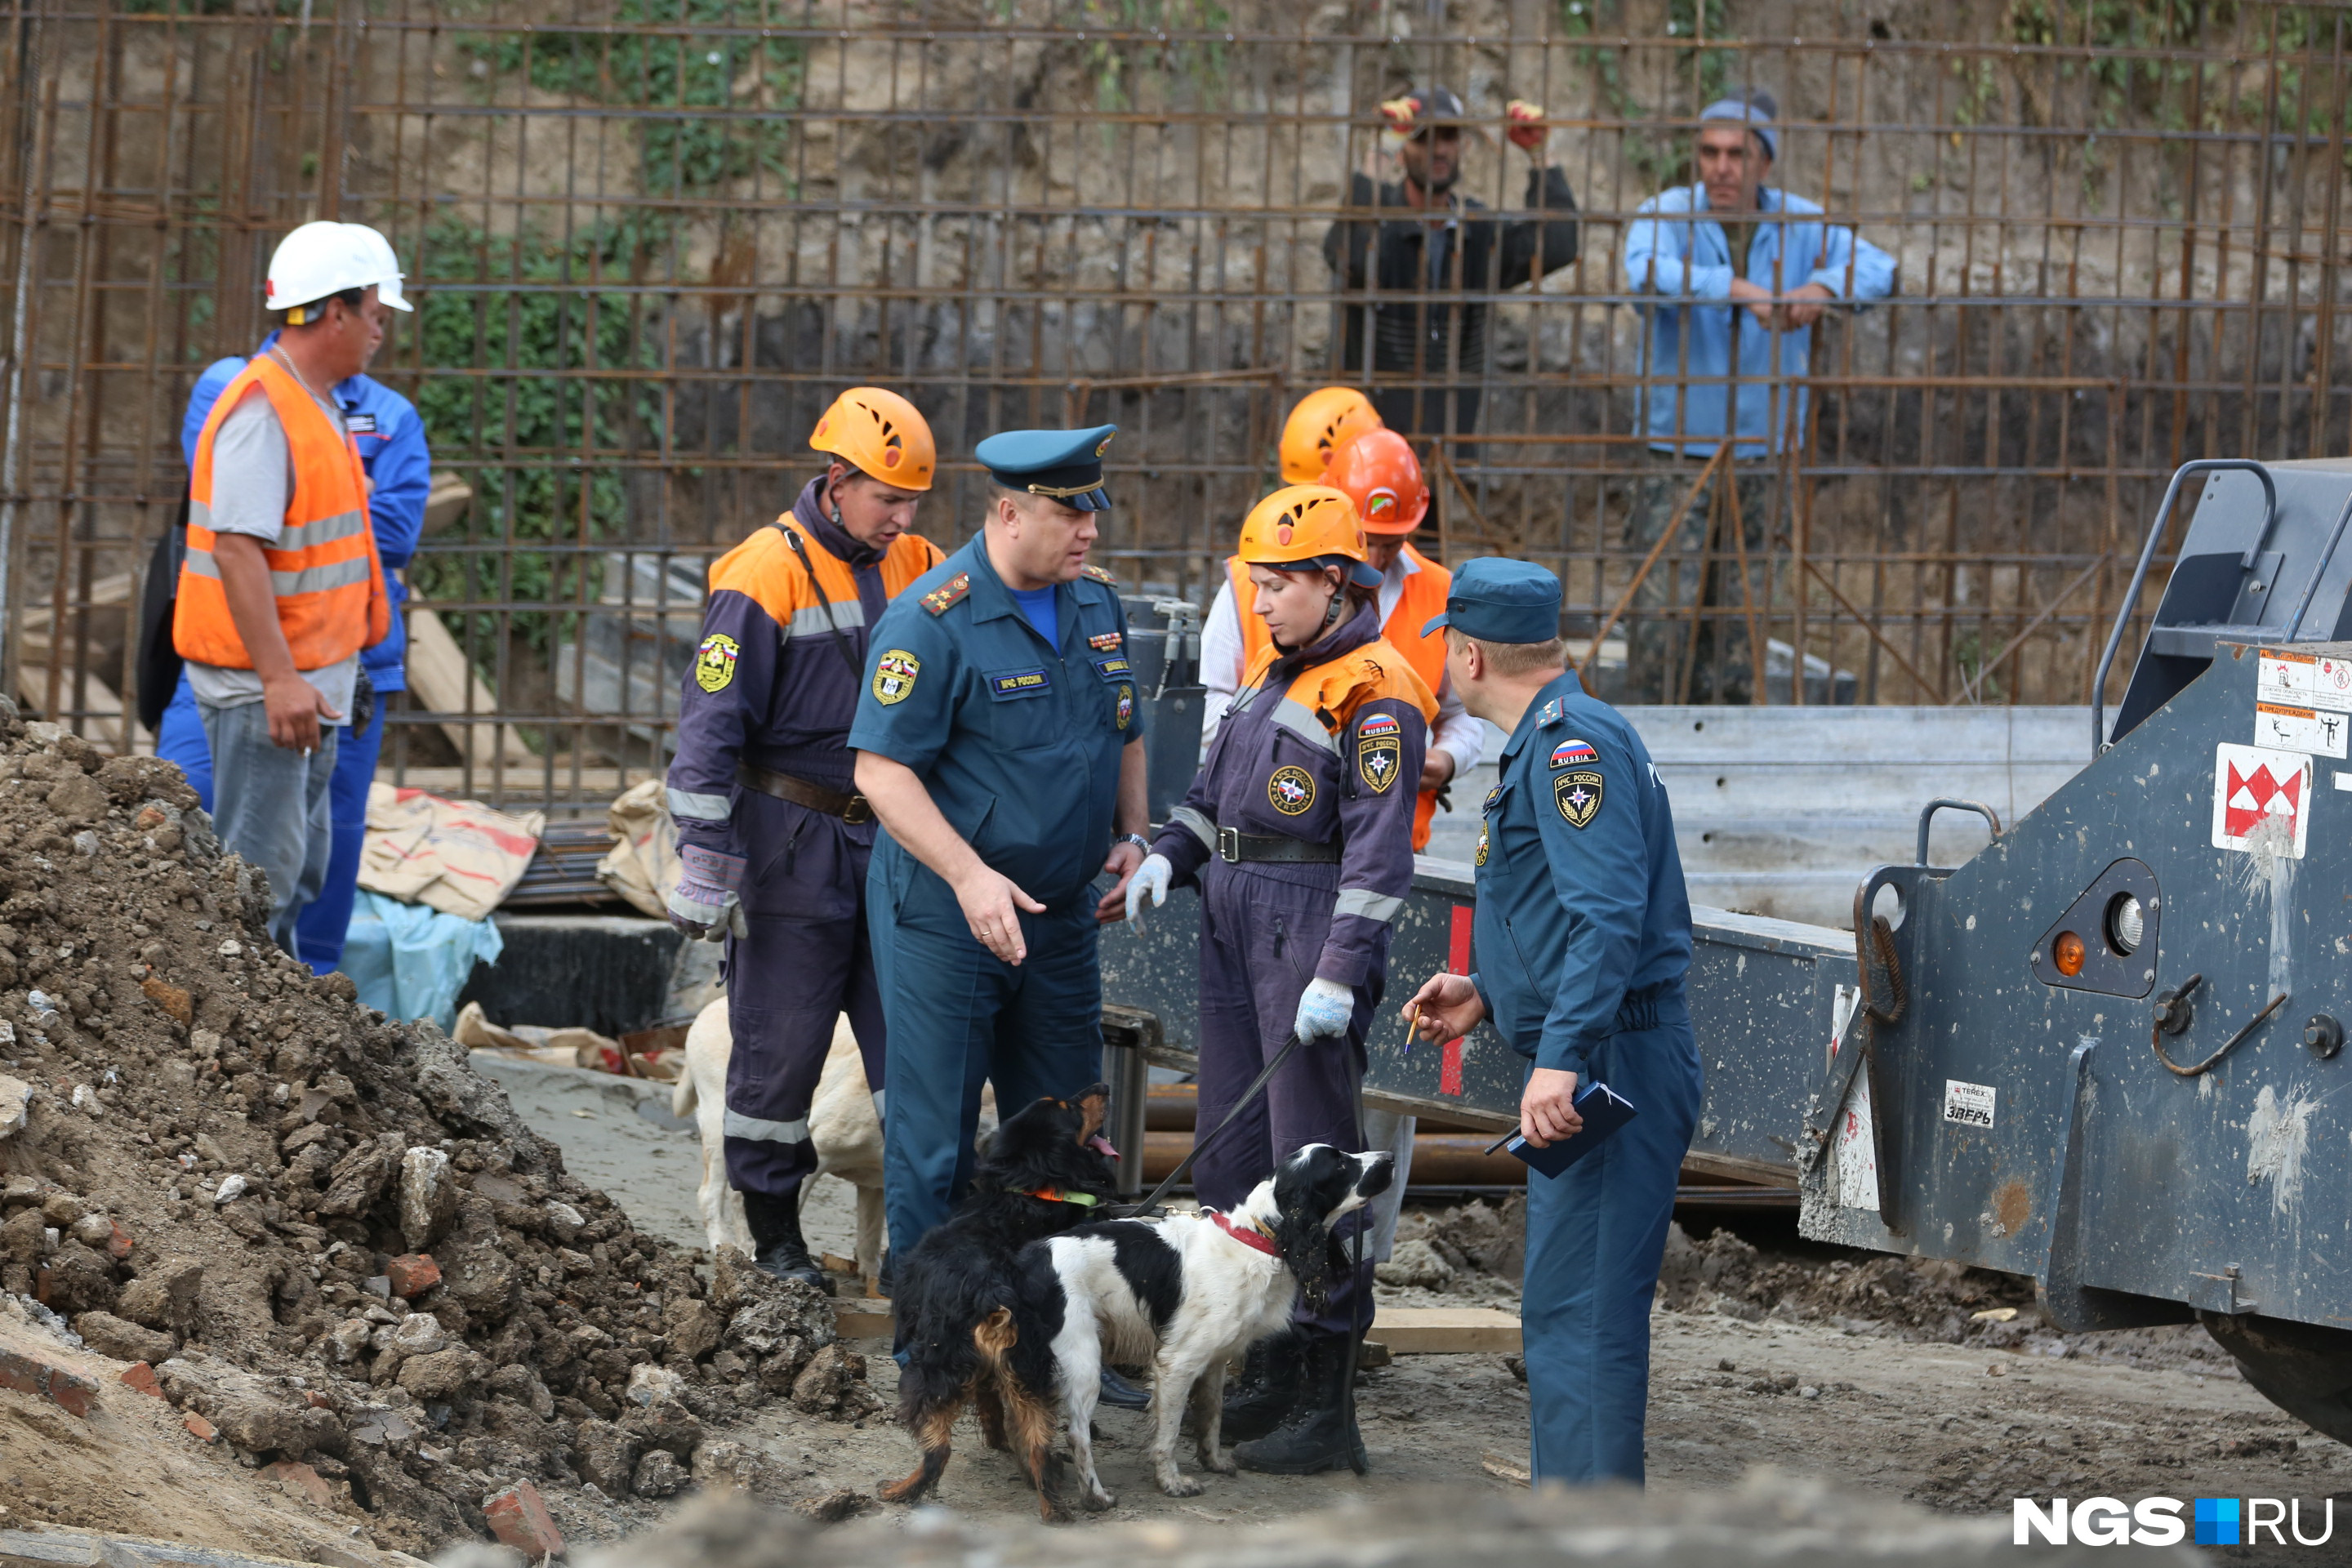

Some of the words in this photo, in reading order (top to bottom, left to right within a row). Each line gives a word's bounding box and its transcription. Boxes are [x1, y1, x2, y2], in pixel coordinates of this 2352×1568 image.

[1000, 678, 1017, 689] МЧС
[1017, 674, 1043, 686] РОССИИ
[2265, 706, 2314, 718] ПРЕДУПРЕЖДЕНИЕ
[1365, 725, 1394, 735] RUSSIA
[1362, 742, 1374, 751] МЧС
[1557, 754, 1589, 764] RUSSIA
[1276, 769, 1290, 780] МЧС
[1292, 769, 1312, 792] РОССИИ
[1557, 776, 1570, 787] МЧС
[1573, 774, 1599, 783] РОССИИ
[1272, 787, 1309, 812] EMERCOM
[1962, 1087, 1985, 1097] TEREX
